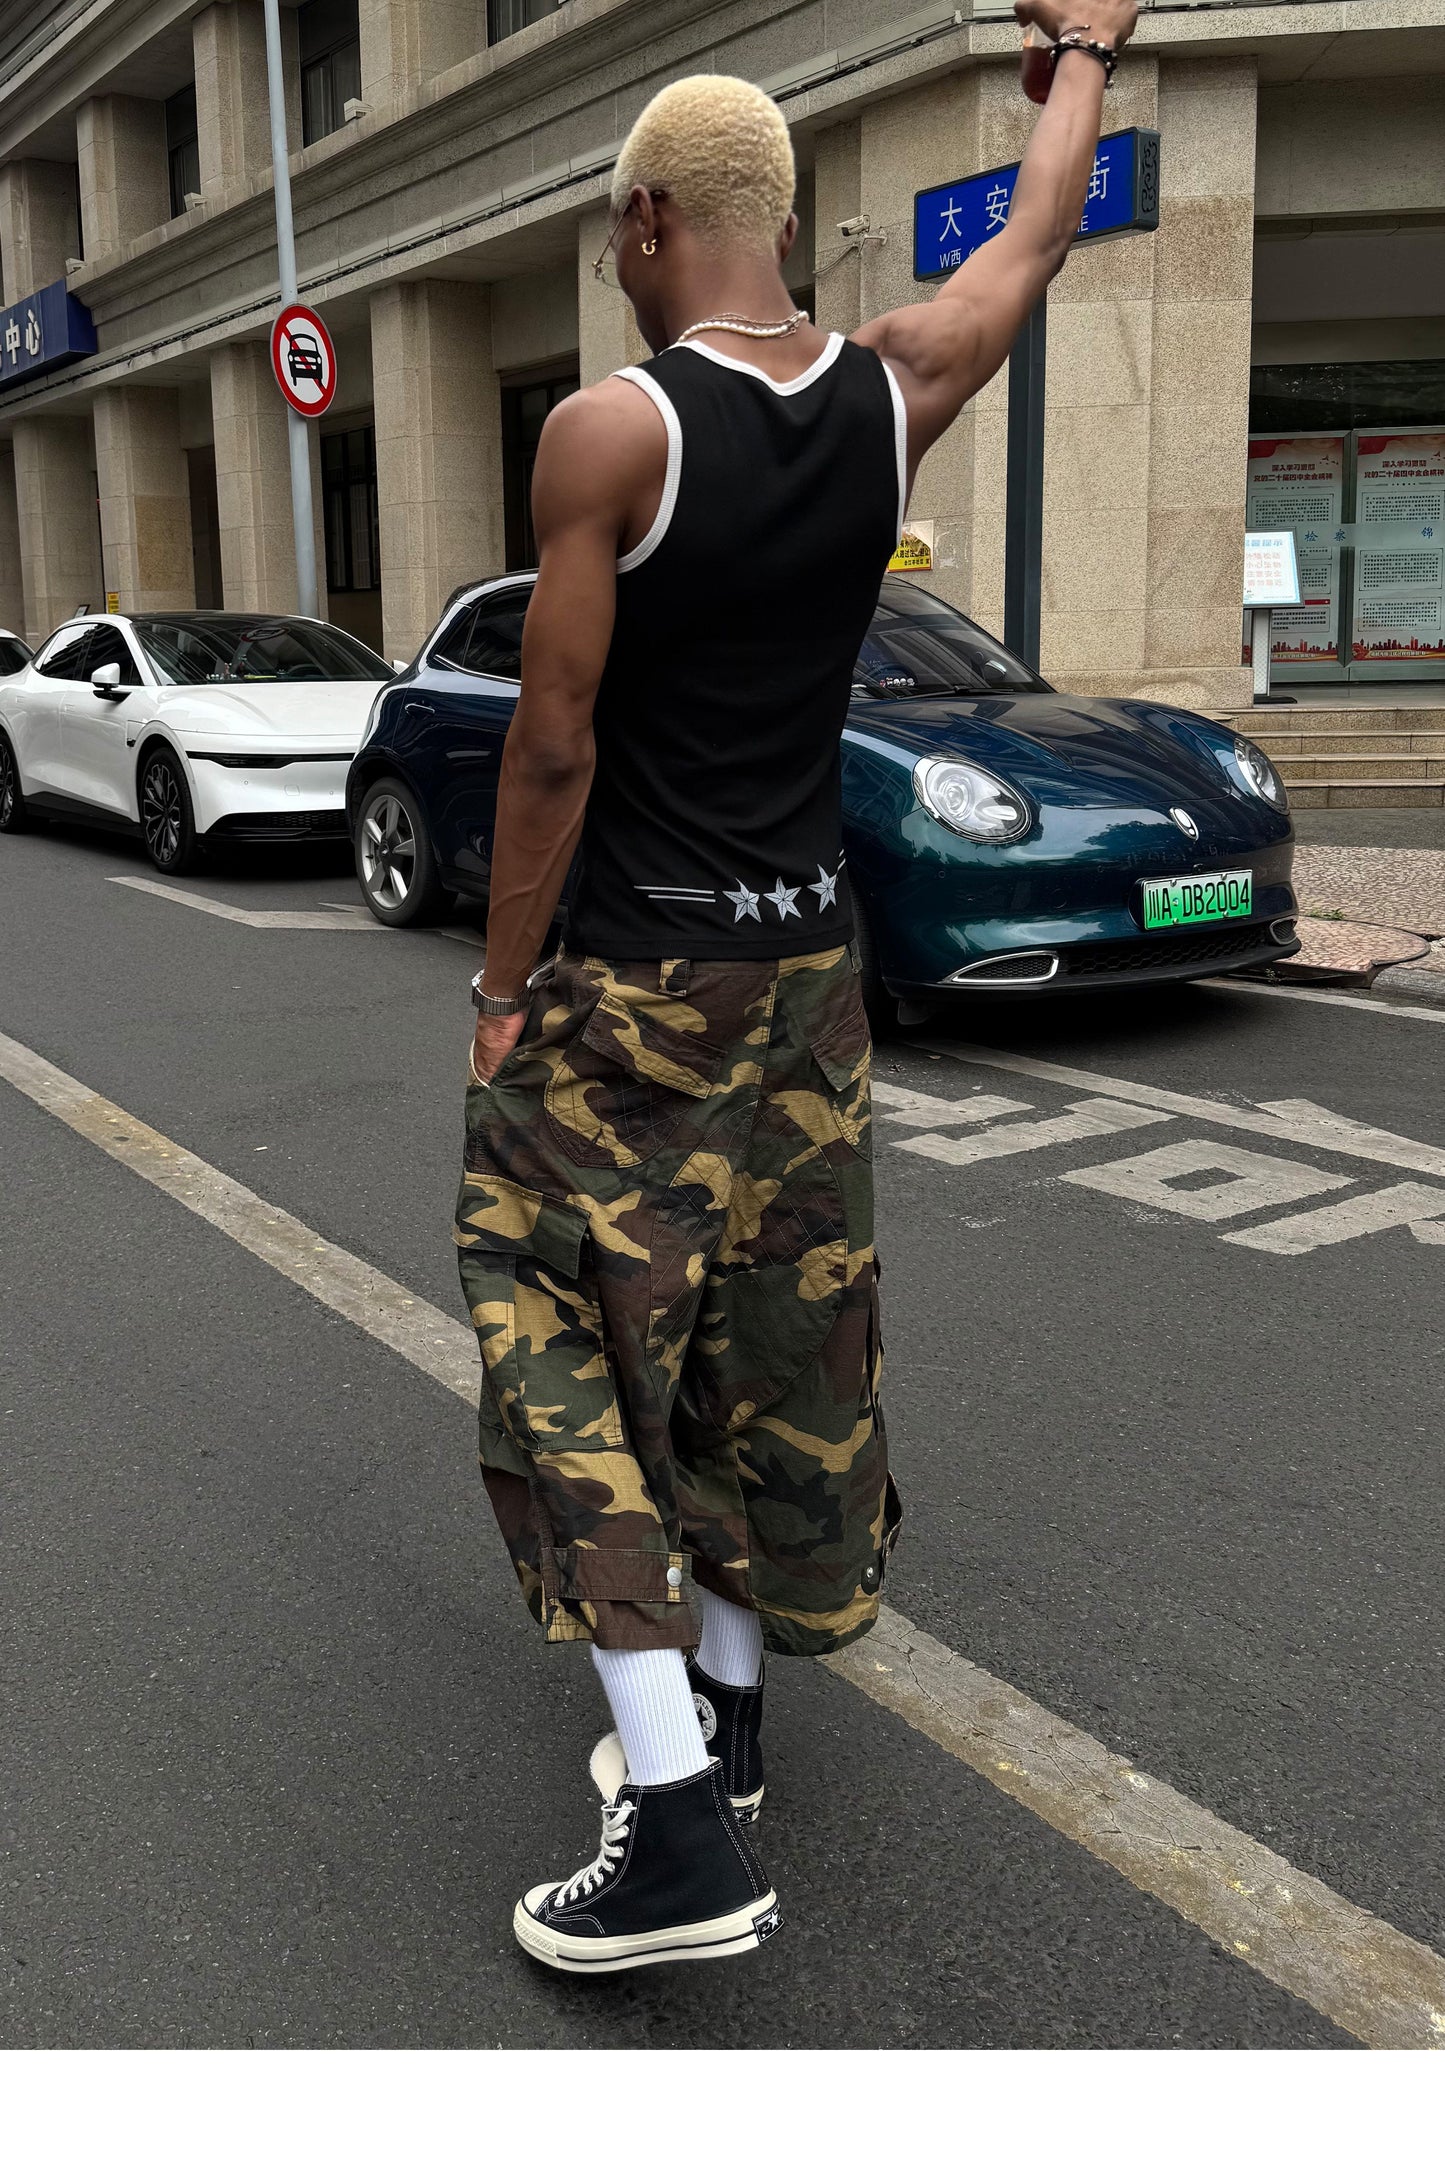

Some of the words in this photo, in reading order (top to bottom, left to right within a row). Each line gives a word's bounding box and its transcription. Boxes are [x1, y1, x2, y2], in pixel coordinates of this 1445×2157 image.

[0, 308, 41, 370] 中心
[1253, 472, 1333, 482] 党的二十届四中全会精神
[1364, 468, 1445, 478] 党的二十届四中全会精神
